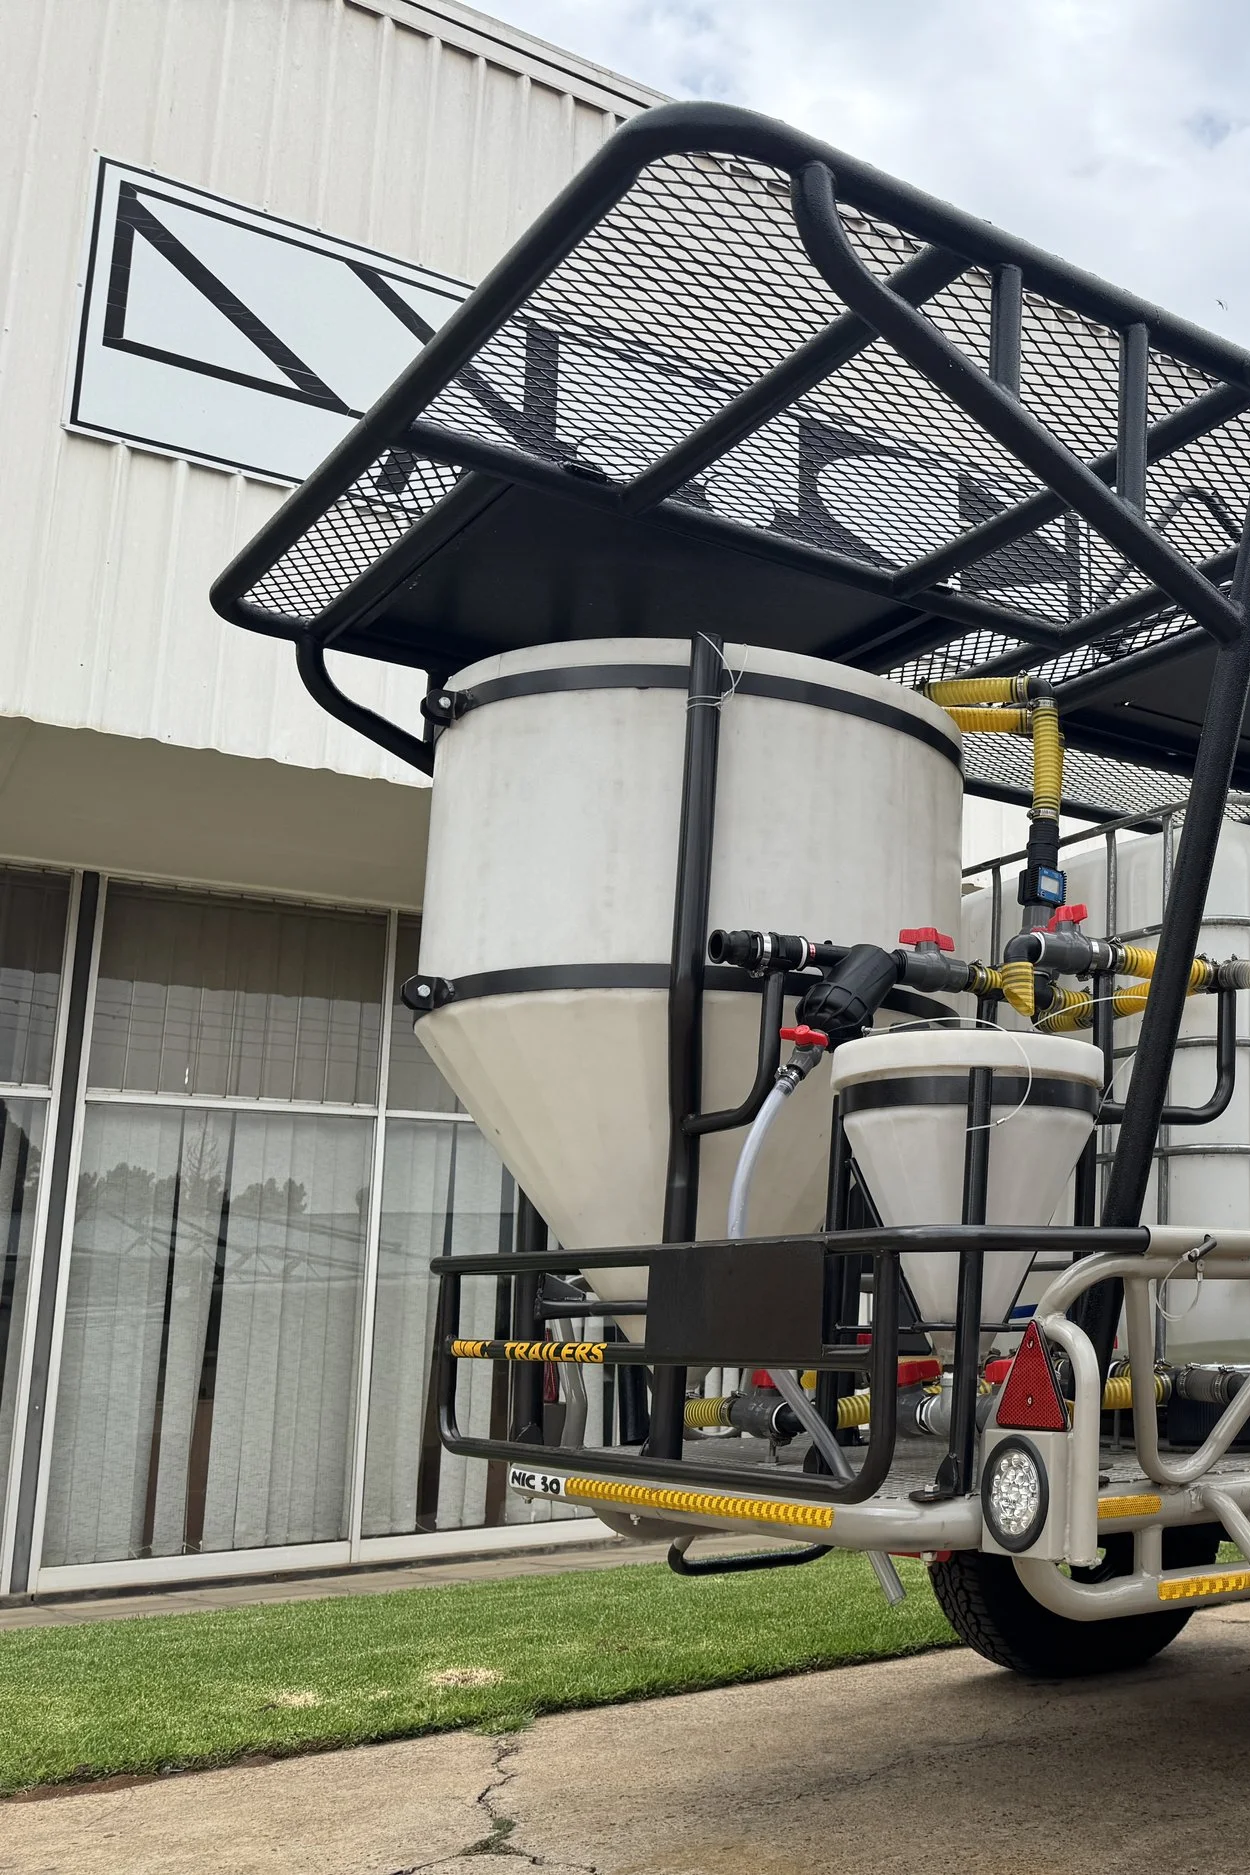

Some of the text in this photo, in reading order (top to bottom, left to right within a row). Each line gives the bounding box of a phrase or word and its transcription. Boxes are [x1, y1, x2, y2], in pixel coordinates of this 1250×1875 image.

[504, 1342, 607, 1363] TRAILERS
[511, 1470, 560, 1495] NIC 30
